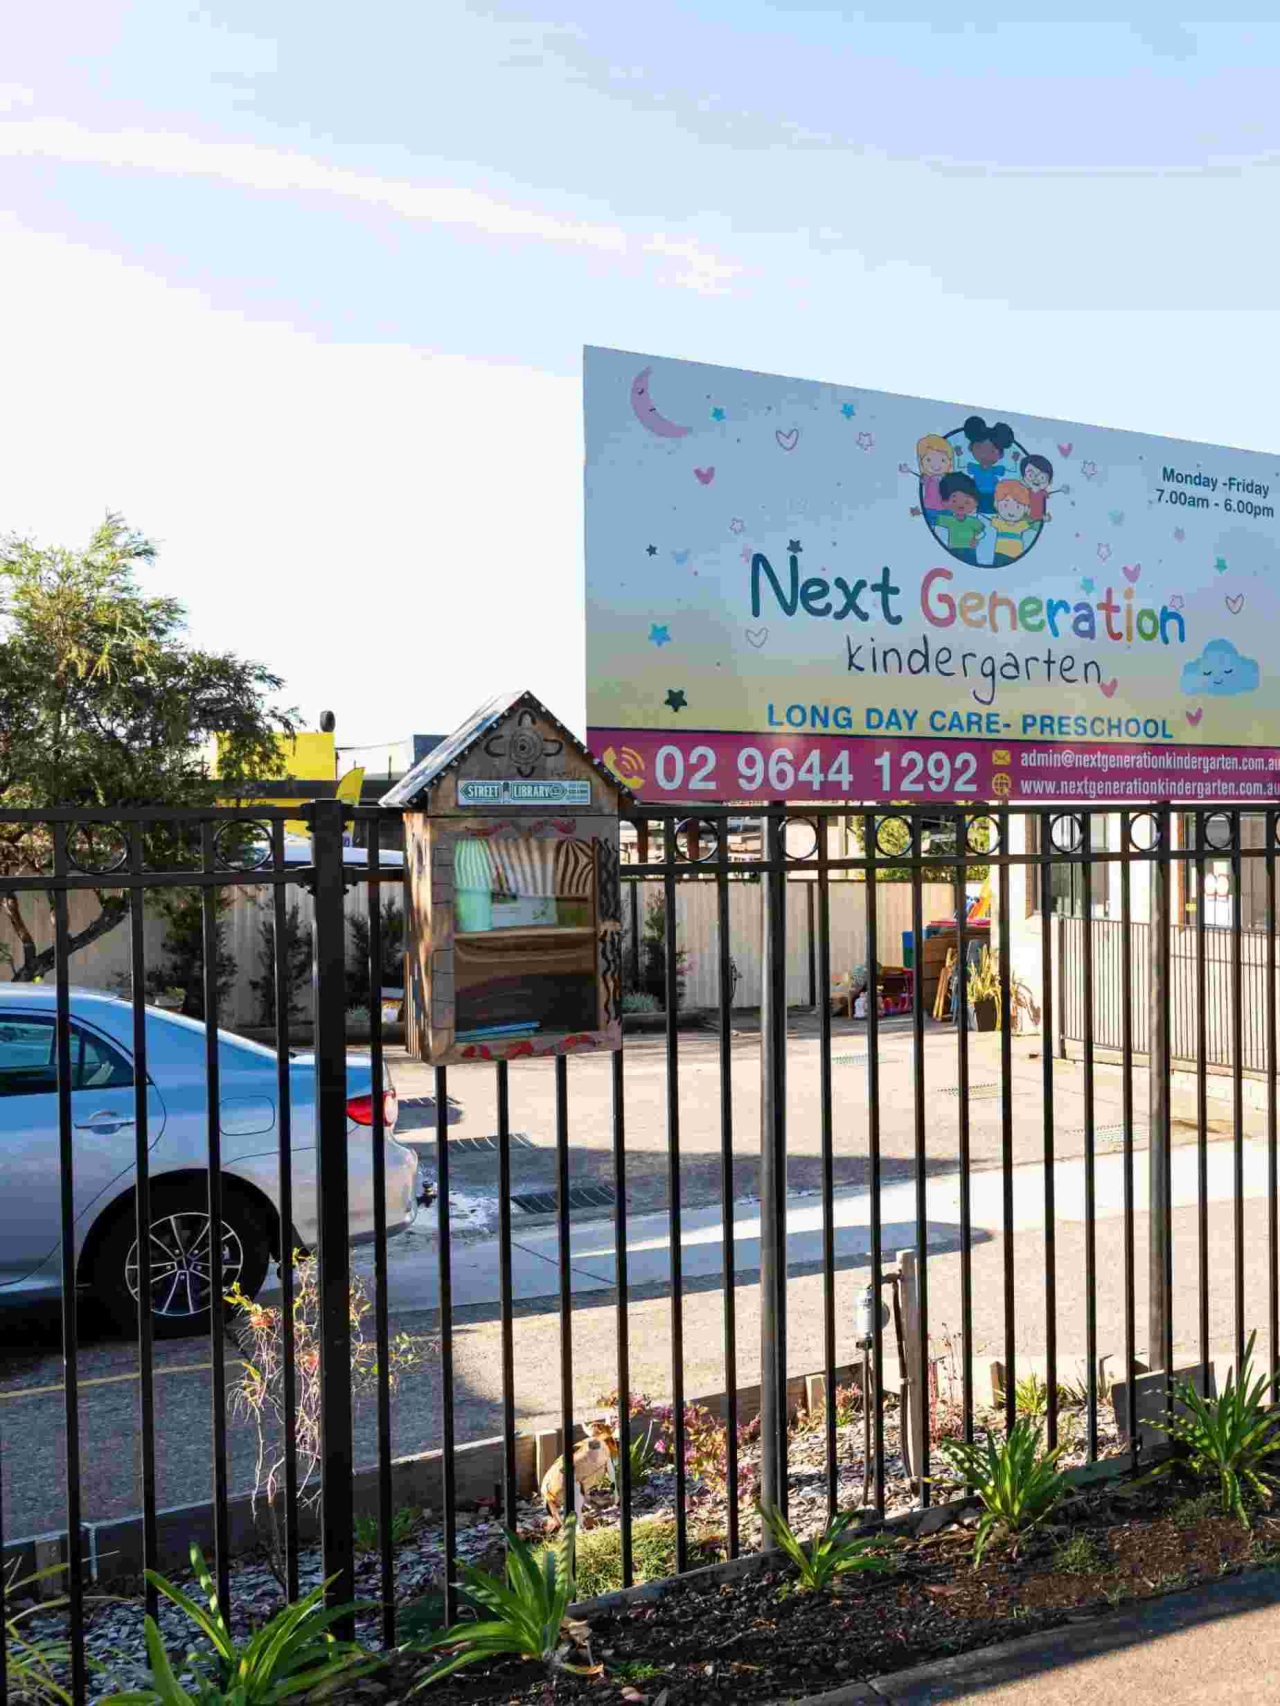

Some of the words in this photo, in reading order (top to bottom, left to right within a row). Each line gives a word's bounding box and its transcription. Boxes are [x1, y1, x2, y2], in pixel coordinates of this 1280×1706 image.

[1161, 465, 1218, 491] Monday
[1155, 488, 1210, 509] 7.00am
[1223, 498, 1275, 519] 6.00pm
[751, 552, 903, 626] Next
[920, 567, 1186, 645] Generation
[846, 633, 1102, 706] kindergarten
[767, 703, 853, 729] LONG
[865, 707, 919, 731] DAY
[1021, 713, 1174, 739] PRESCHOOL
[654, 744, 718, 791] 02
[736, 746, 854, 792] 9644
[874, 749, 978, 793] 1292
[468, 785, 499, 798] STREET
[513, 785, 550, 798] LIBRARY
[1020, 776, 1280, 798] www.nextgenerationkindergarten.com.au
